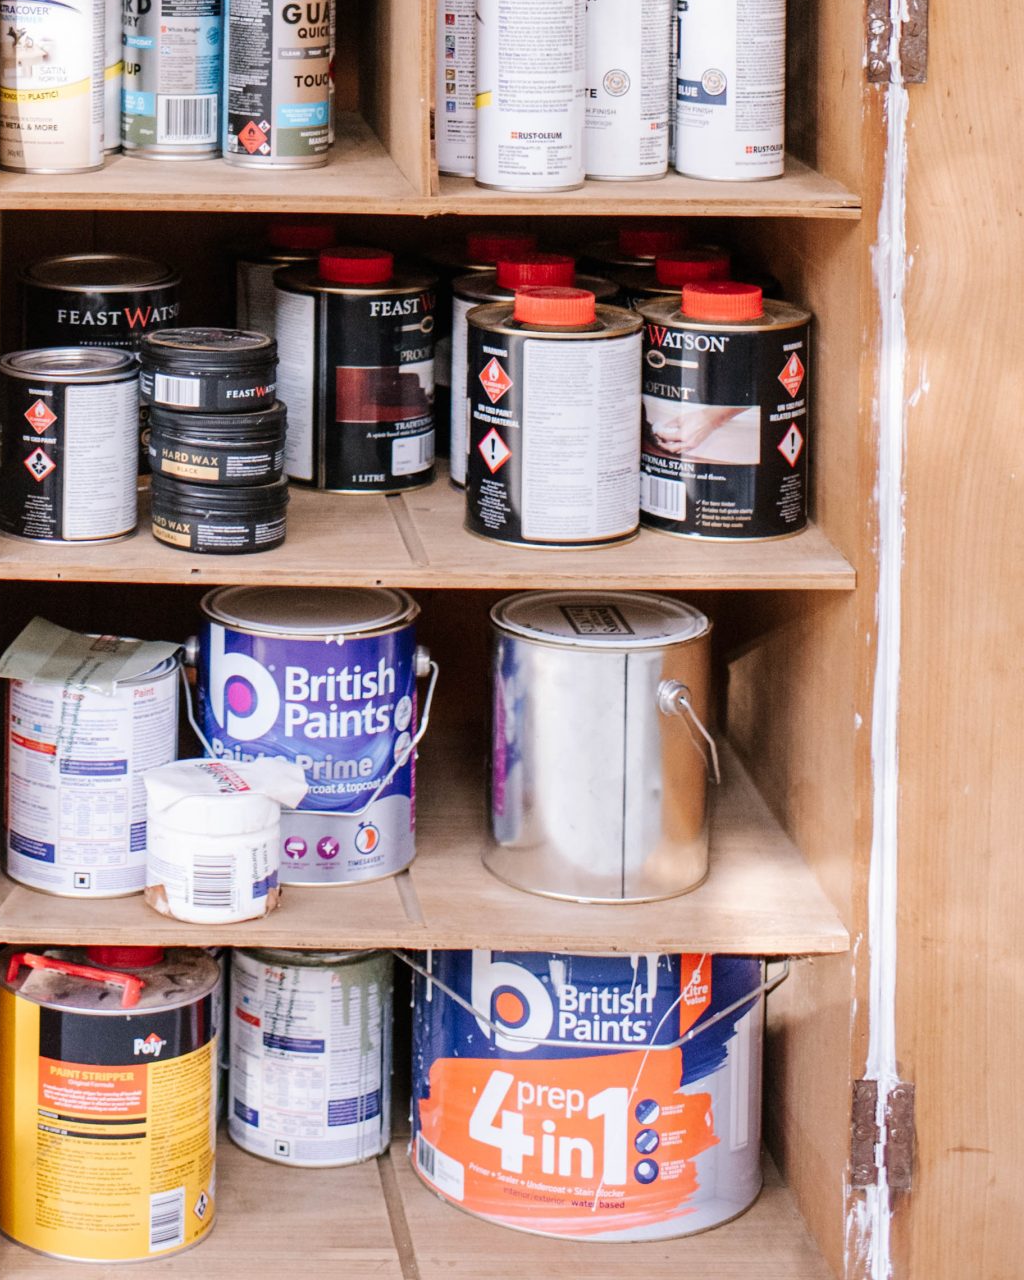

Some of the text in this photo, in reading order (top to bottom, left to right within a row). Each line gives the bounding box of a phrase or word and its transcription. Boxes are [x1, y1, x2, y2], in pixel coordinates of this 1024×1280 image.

[40, 67, 65, 75] SATIN
[6, 122, 24, 130] METAL
[370, 298, 419, 316] FEAST
[57, 308, 121, 326] FEAST
[647, 325, 726, 352] WATSON
[226, 387, 255, 398] FEAST
[162, 448, 219, 466] HARD WAX
[669, 461, 694, 471] STAIN
[176, 466, 198, 475] BLACK
[358, 473, 385, 483] LITRE
[168, 521, 190, 533] WAX
[285, 657, 395, 702] British
[133, 687, 154, 699] Paint
[285, 704, 390, 739] Paints
[295, 755, 372, 781] Prime
[337, 784, 345, 794] &
[558, 984, 652, 1015] British
[558, 1015, 647, 1042] Paints
[134, 1036, 162, 1056] Poly
[50, 1066, 134, 1081] PAINT STRIPPER
[517, 1080, 584, 1117] prep
[469, 1162, 490, 1176] Primer
[498, 1172, 519, 1184] Sealer
[526, 1179, 566, 1194] Undercoat
[575, 1187, 594, 1197] Stain
[599, 1200, 624, 1209] based
